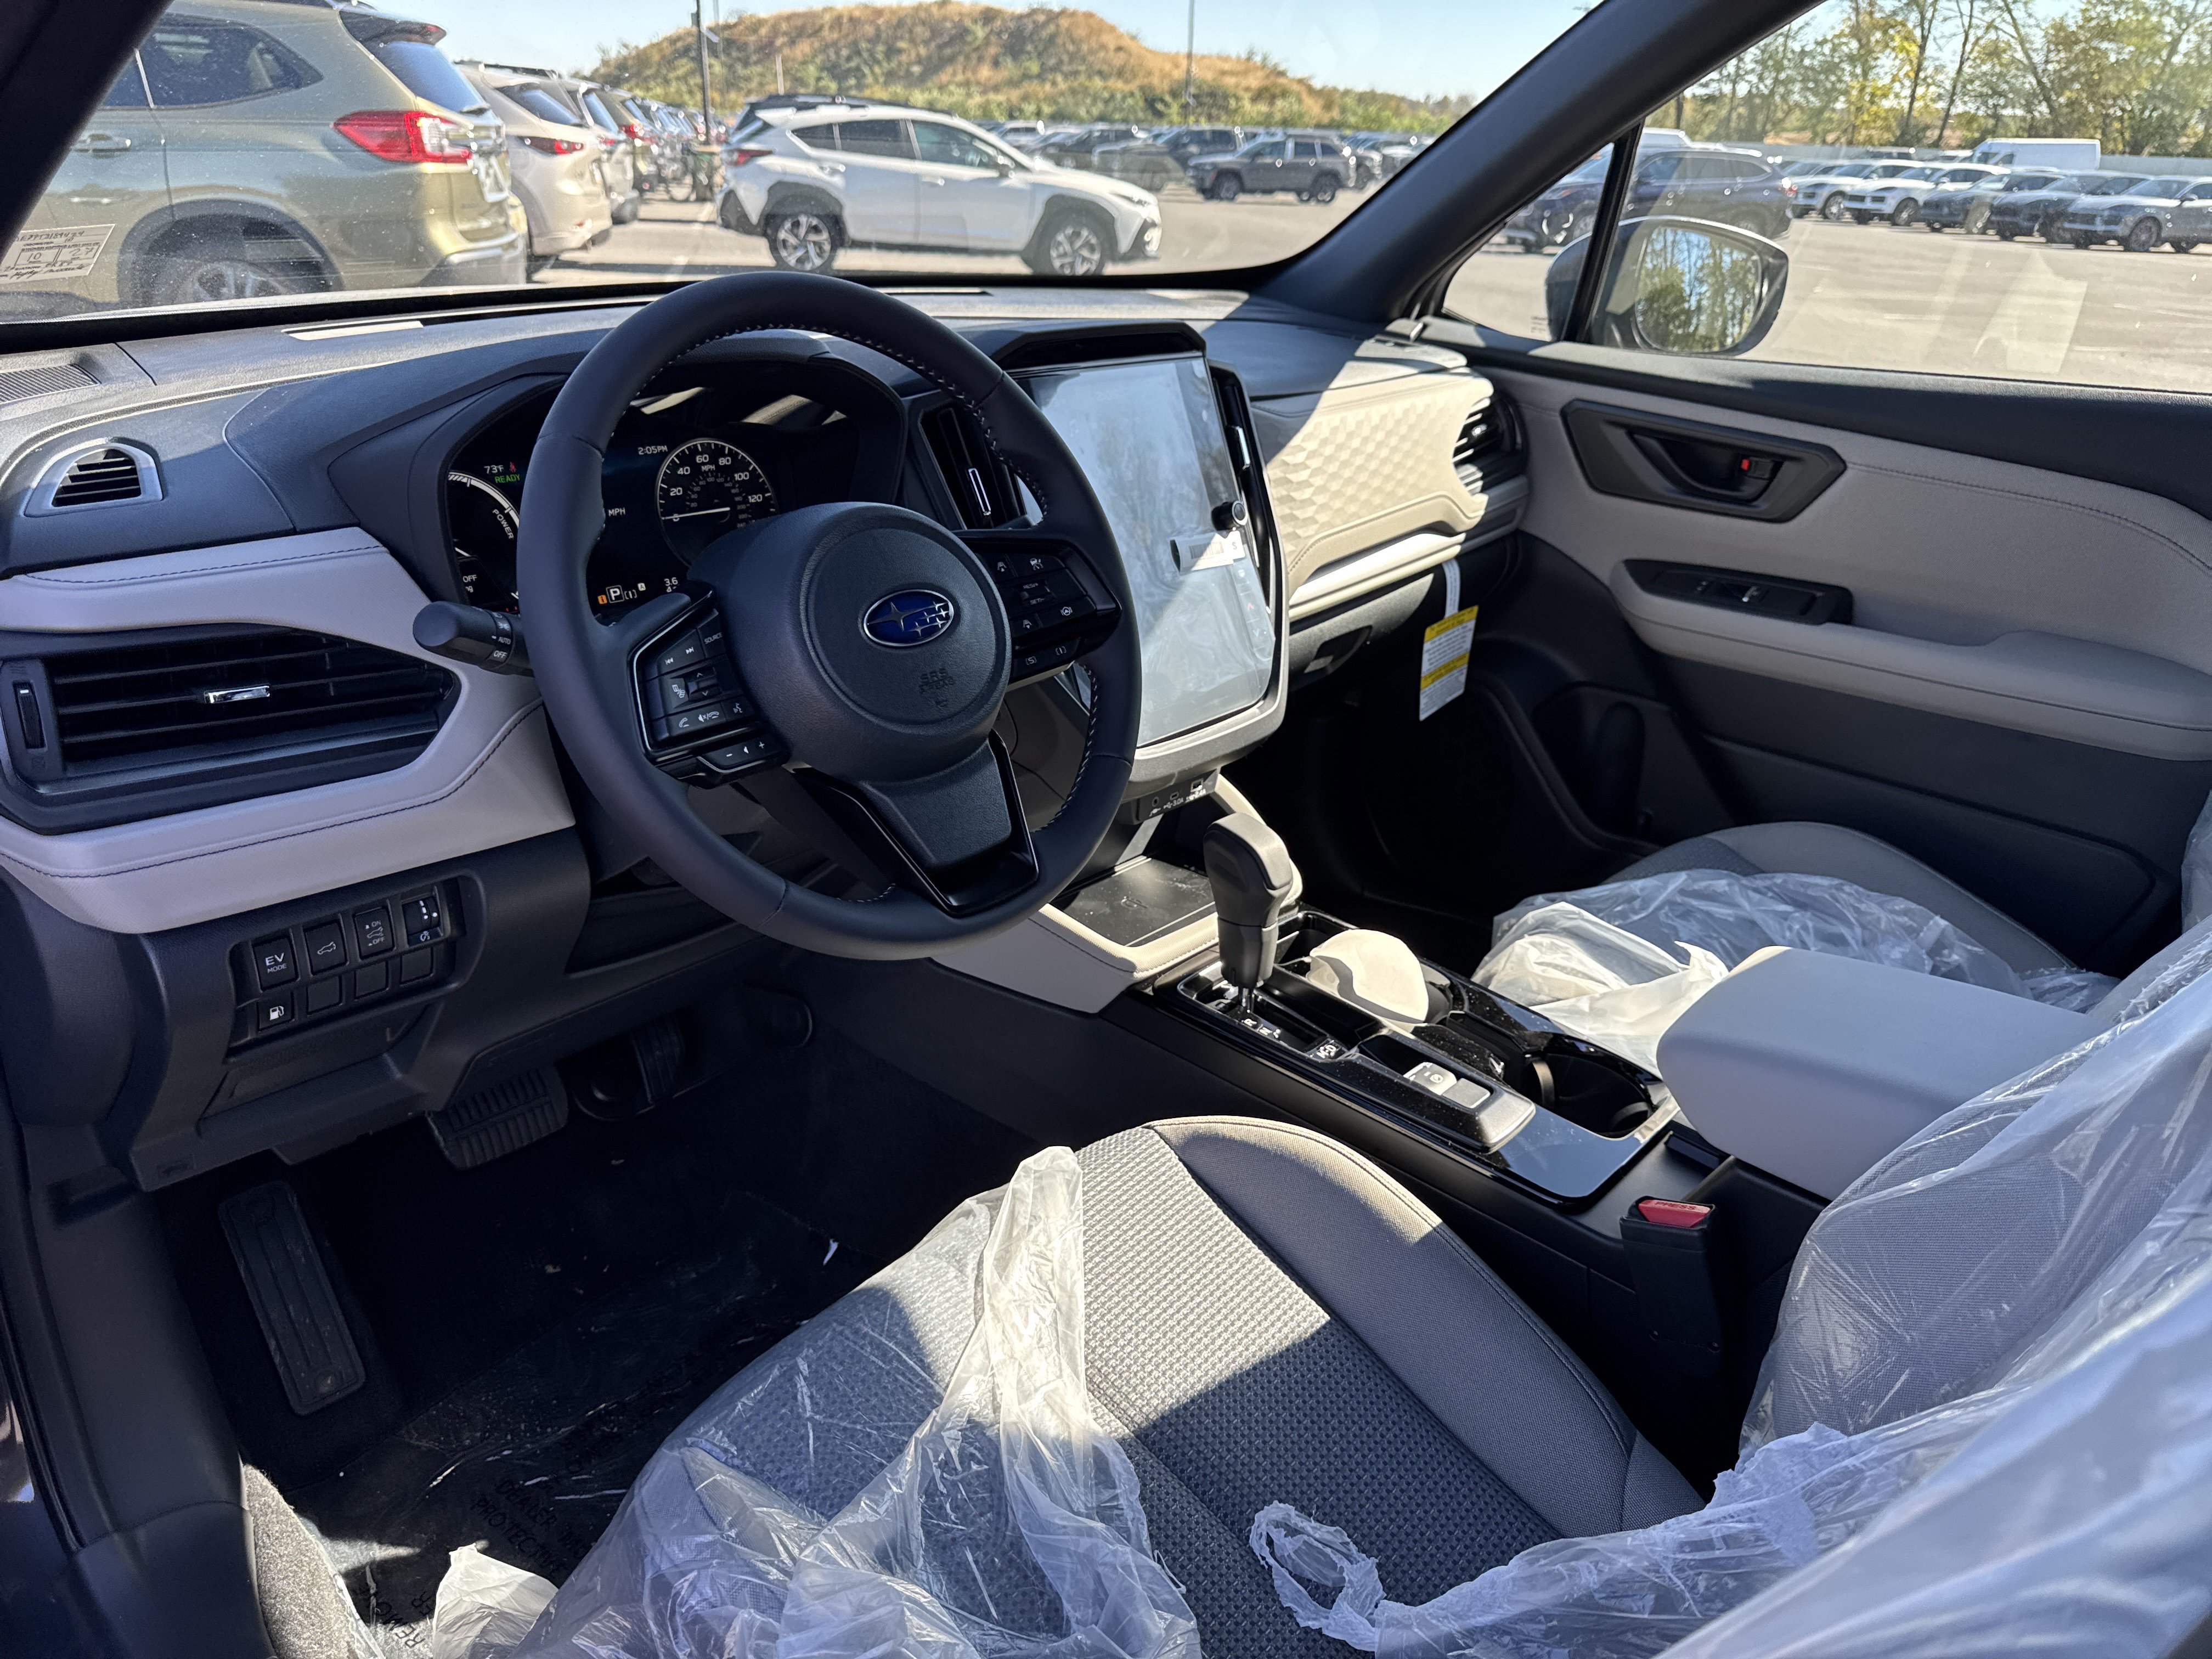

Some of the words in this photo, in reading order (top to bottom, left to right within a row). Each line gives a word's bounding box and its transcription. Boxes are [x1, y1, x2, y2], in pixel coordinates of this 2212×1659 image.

[27, 252, 42, 262] 10
[696, 454, 709, 463] 60
[718, 456, 731, 466] 80
[677, 466, 691, 475] 40
[494, 474, 520, 483] READY
[734, 472, 749, 481] 100
[670, 487, 683, 496] 20
[748, 494, 763, 503] 120
[608, 507, 626, 517] MPH
[492, 509, 514, 540] POWER
[462, 574, 477, 583] OFF
[610, 588, 620, 600] P
[498, 636, 511, 645] AUTO
[704, 632, 723, 644] SOURCE
[493, 650, 507, 659] OFF
[373, 936, 385, 945] OFF
[265, 952, 285, 966] EV
[267, 963, 287, 973] MODE
[1244, 1018, 1257, 1026] R
[1259, 1027, 1273, 1036] N
[1654, 1201, 1696, 1211] PRESS
